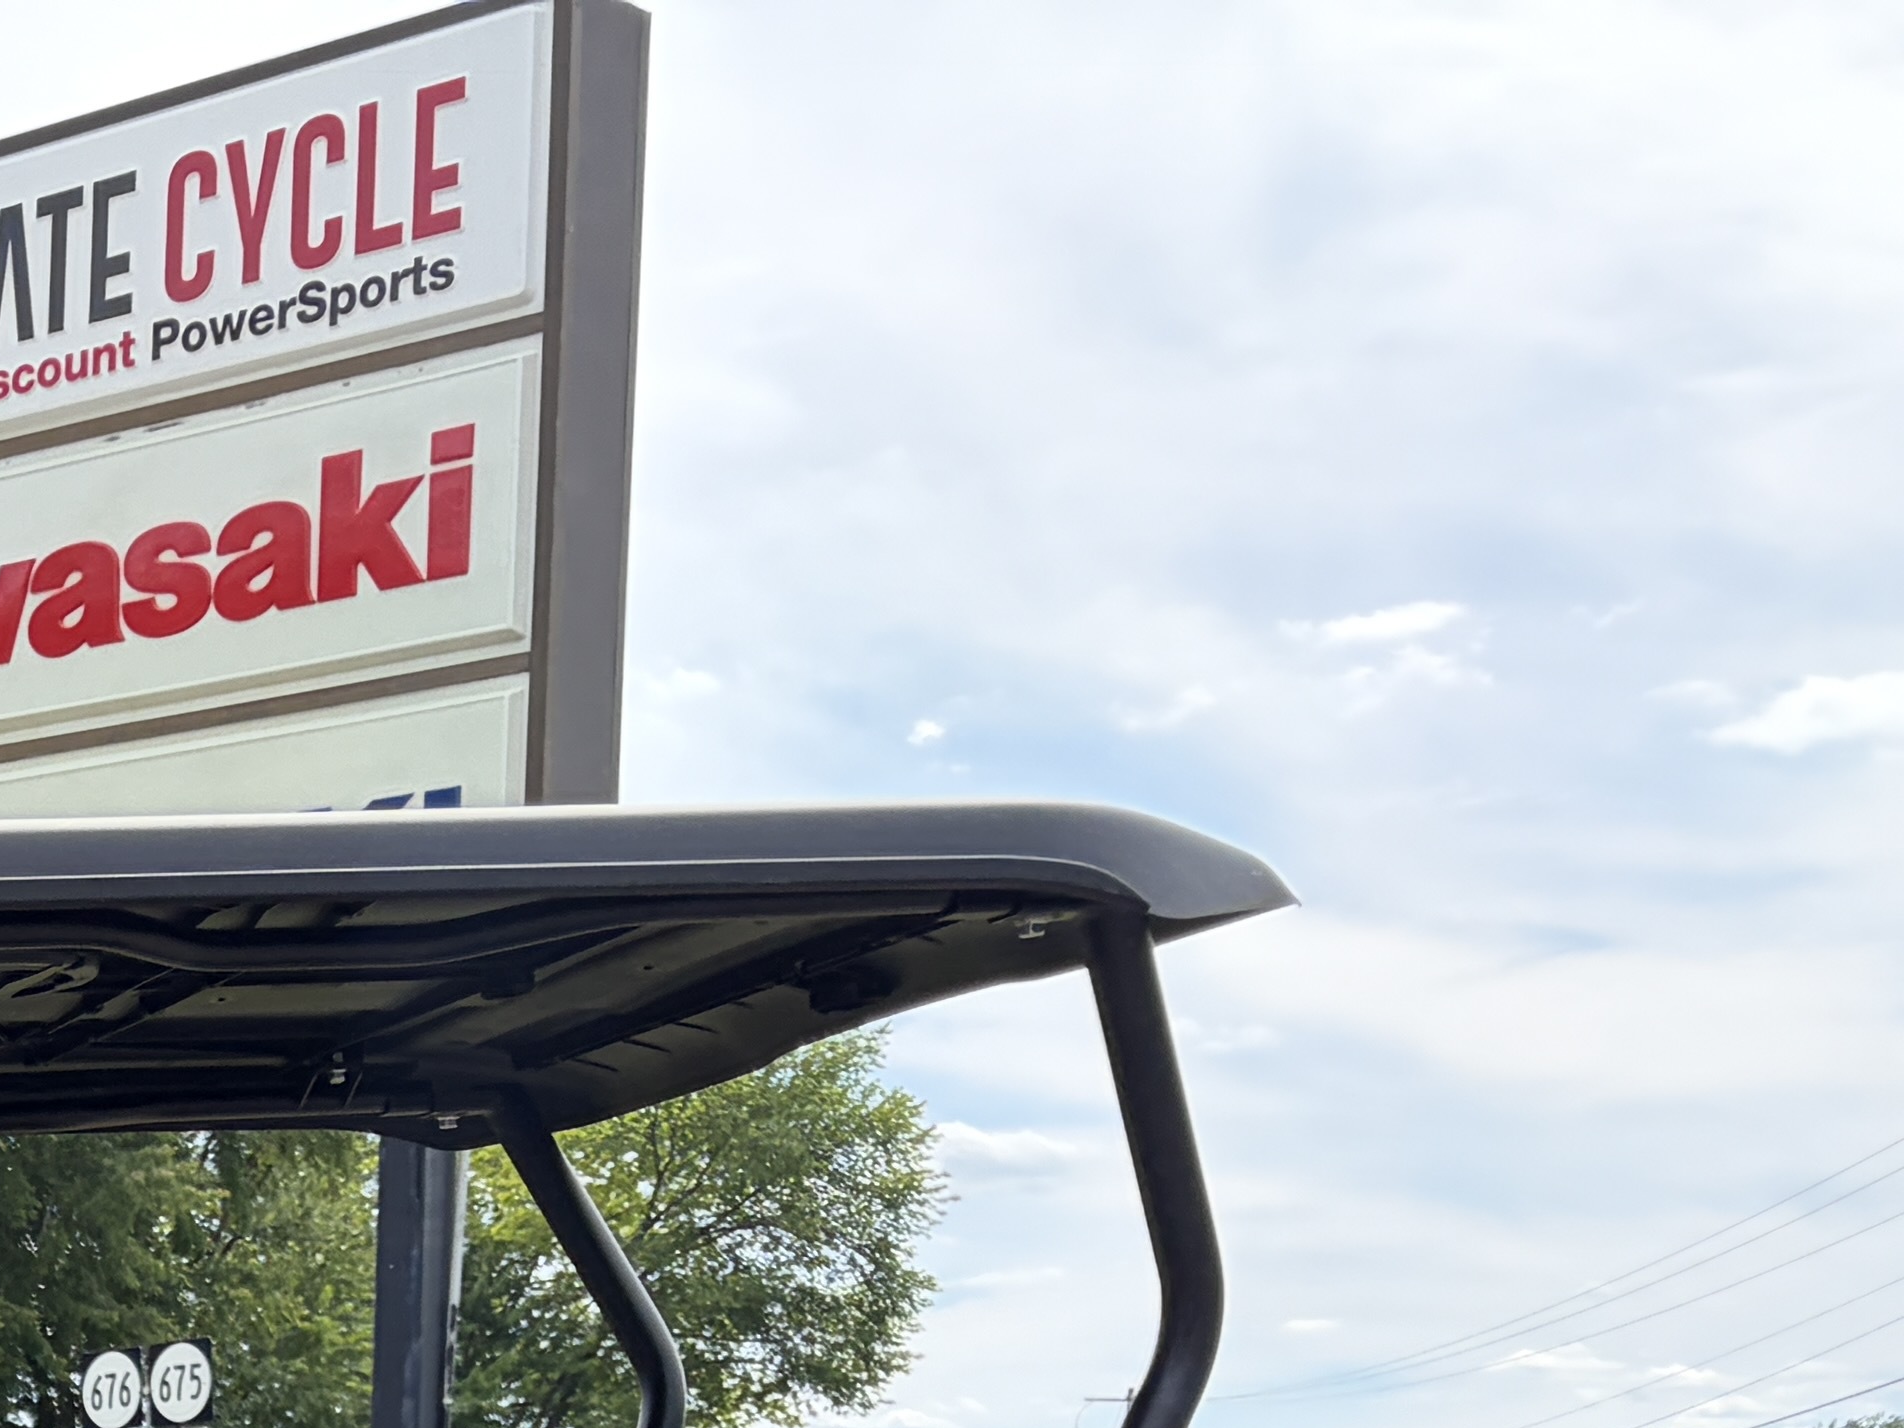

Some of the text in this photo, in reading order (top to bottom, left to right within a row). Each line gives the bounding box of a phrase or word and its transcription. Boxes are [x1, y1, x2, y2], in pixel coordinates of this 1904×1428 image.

[164, 76, 466, 303] CYCLE
[152, 256, 455, 360] PowerSports
[91, 1372, 131, 1411] 676
[159, 1364, 202, 1403] 675
